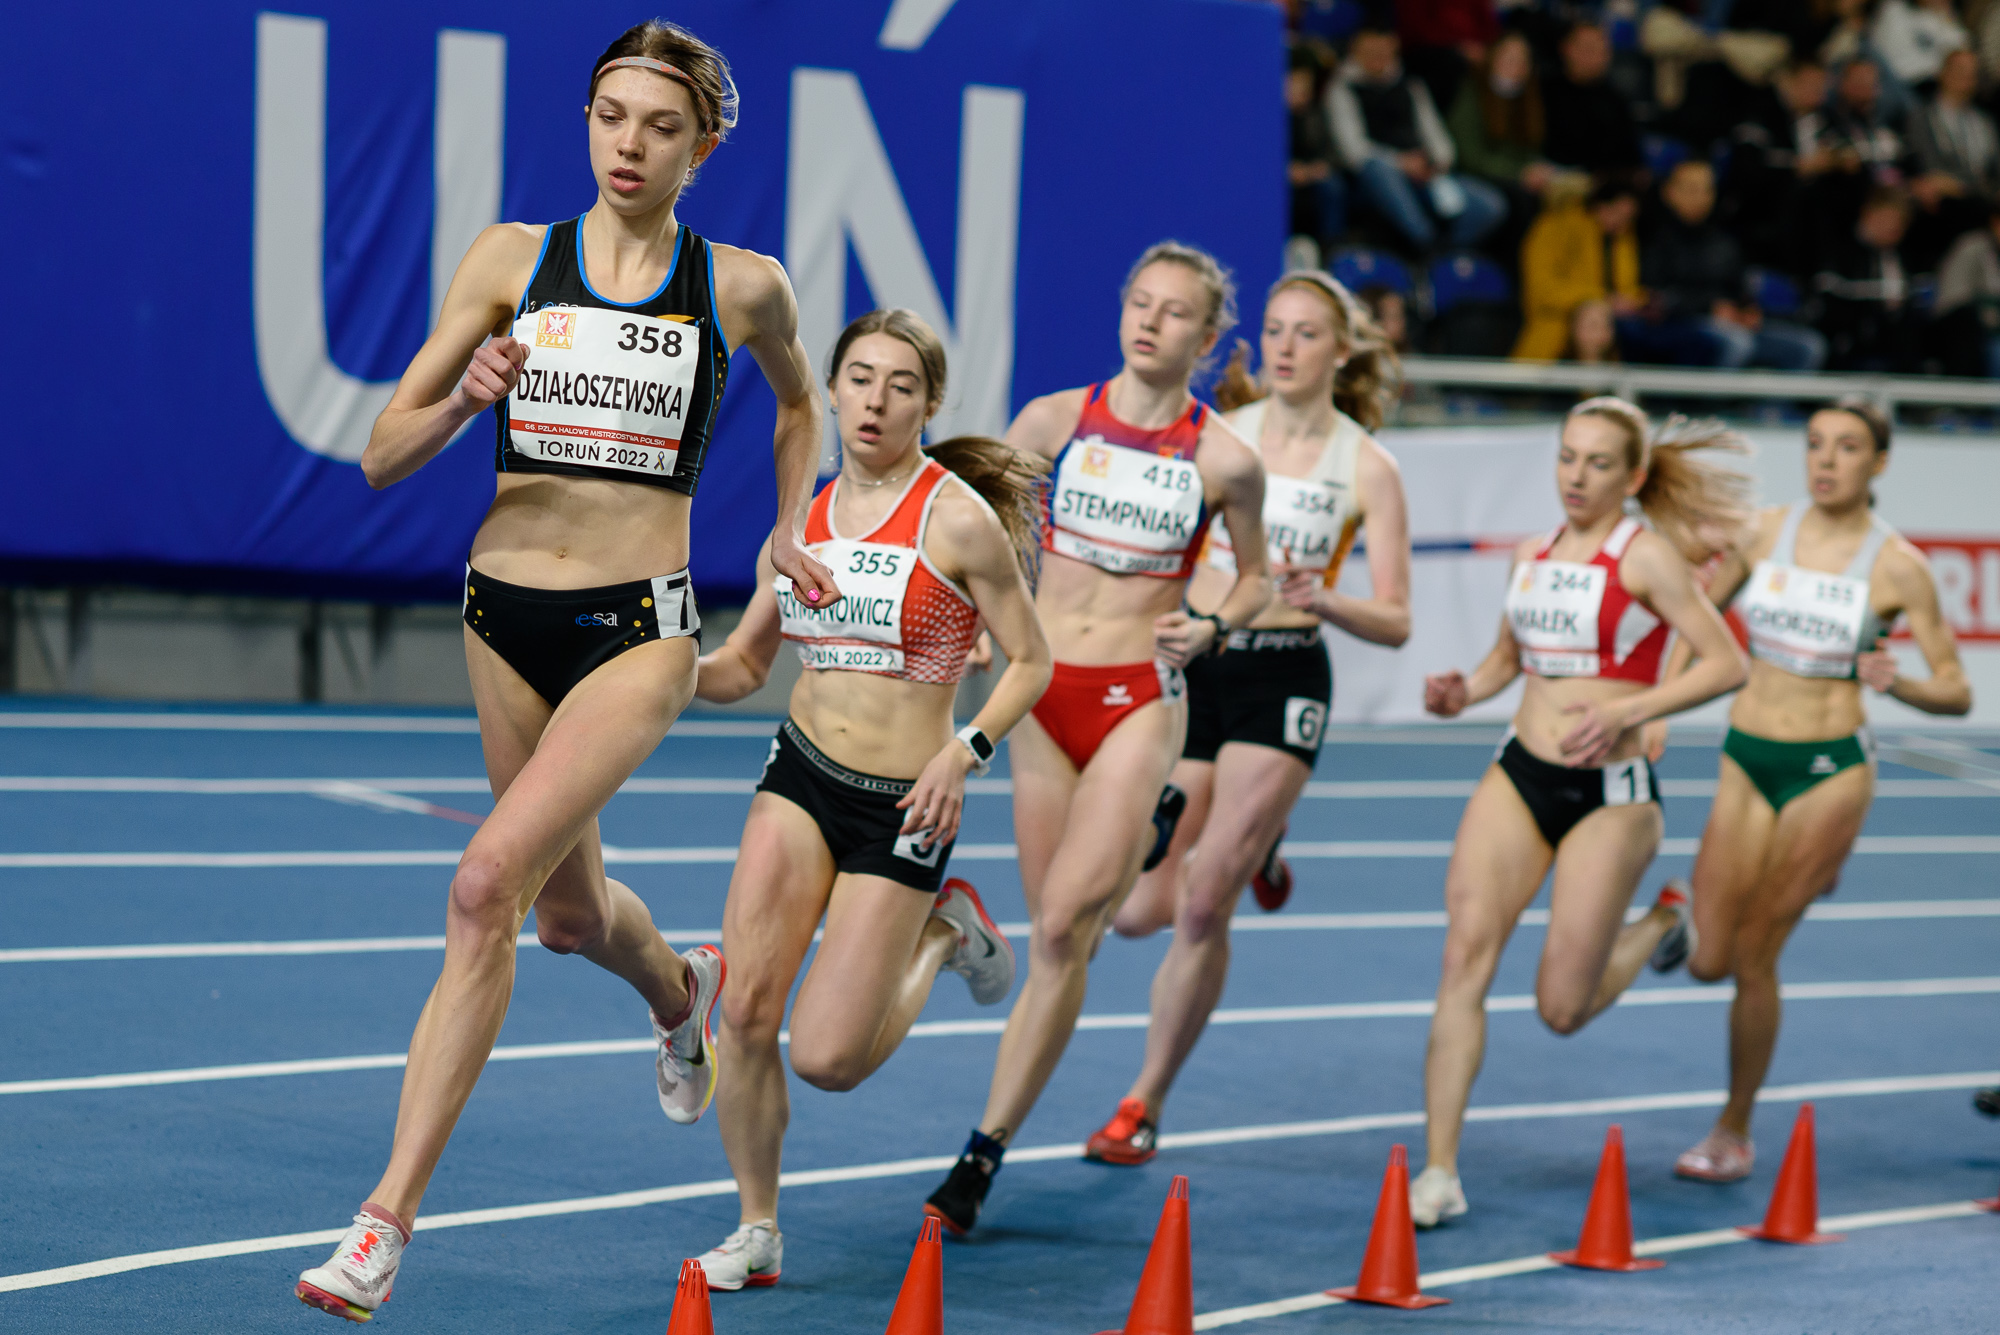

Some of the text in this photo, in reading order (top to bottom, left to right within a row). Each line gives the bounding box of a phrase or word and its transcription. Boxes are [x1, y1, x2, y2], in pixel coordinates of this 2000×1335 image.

[538, 335, 570, 347] PZLA
[617, 322, 683, 358] 358
[517, 368, 683, 420] DZIAŁOSZEWSKA
[525, 423, 666, 447] 66. PZLA HALOWE MISTRZOSTWA POLSKI
[538, 440, 649, 468] TORUŃ 2022
[1143, 464, 1192, 492] 418
[1061, 488, 1190, 538] STEMPNIAK
[1292, 489, 1336, 517] 354
[849, 550, 900, 576] 355
[1551, 569, 1592, 593] 244
[667, 574, 689, 631] 7
[844, 651, 883, 666] 2022
[1297, 705, 1319, 742] 6
[1620, 765, 1635, 800] 1
